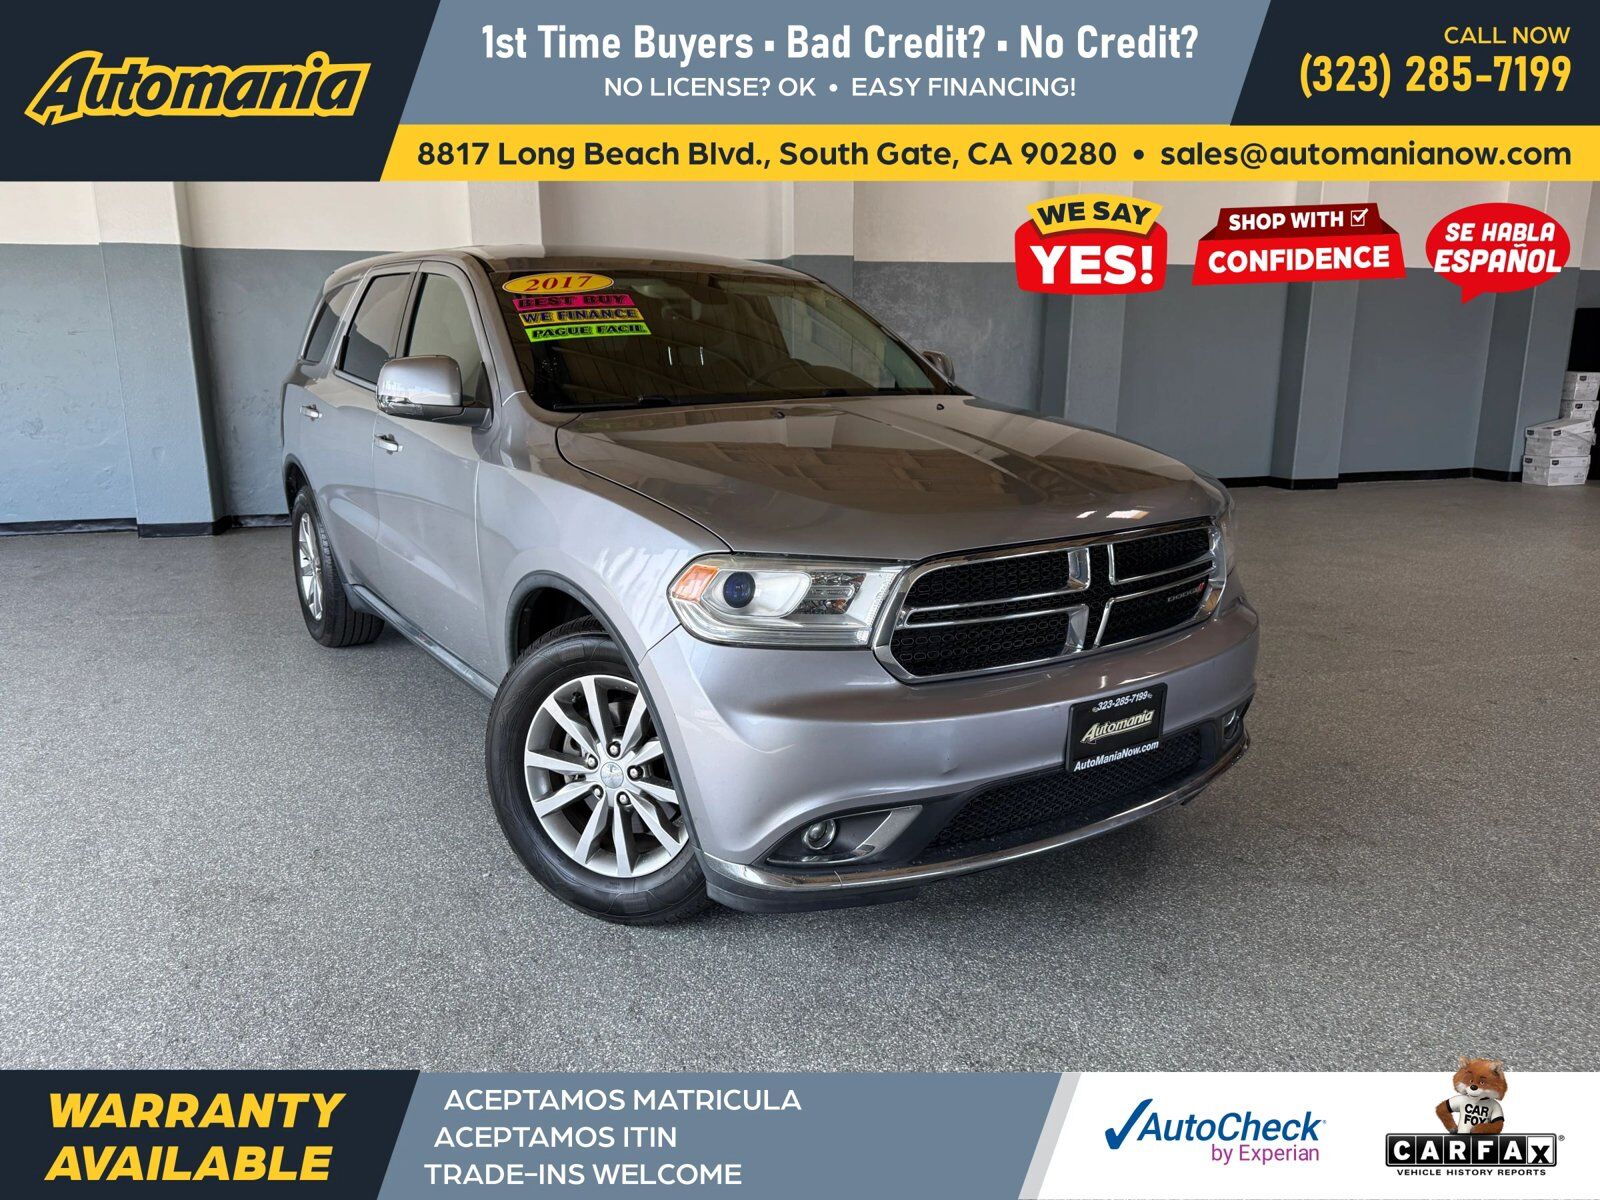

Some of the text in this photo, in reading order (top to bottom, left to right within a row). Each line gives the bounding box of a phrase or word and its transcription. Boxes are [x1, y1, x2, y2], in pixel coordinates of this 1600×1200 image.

[524, 275, 592, 292] 2017
[518, 294, 626, 307] BEST BUY
[522, 308, 640, 323] WE FINANCE
[531, 323, 647, 338] PAGUE FACIL
[1096, 690, 1149, 711] 323-285-7199
[1080, 708, 1156, 742] Automania
[1073, 740, 1160, 772] AutoManiaNow.com
